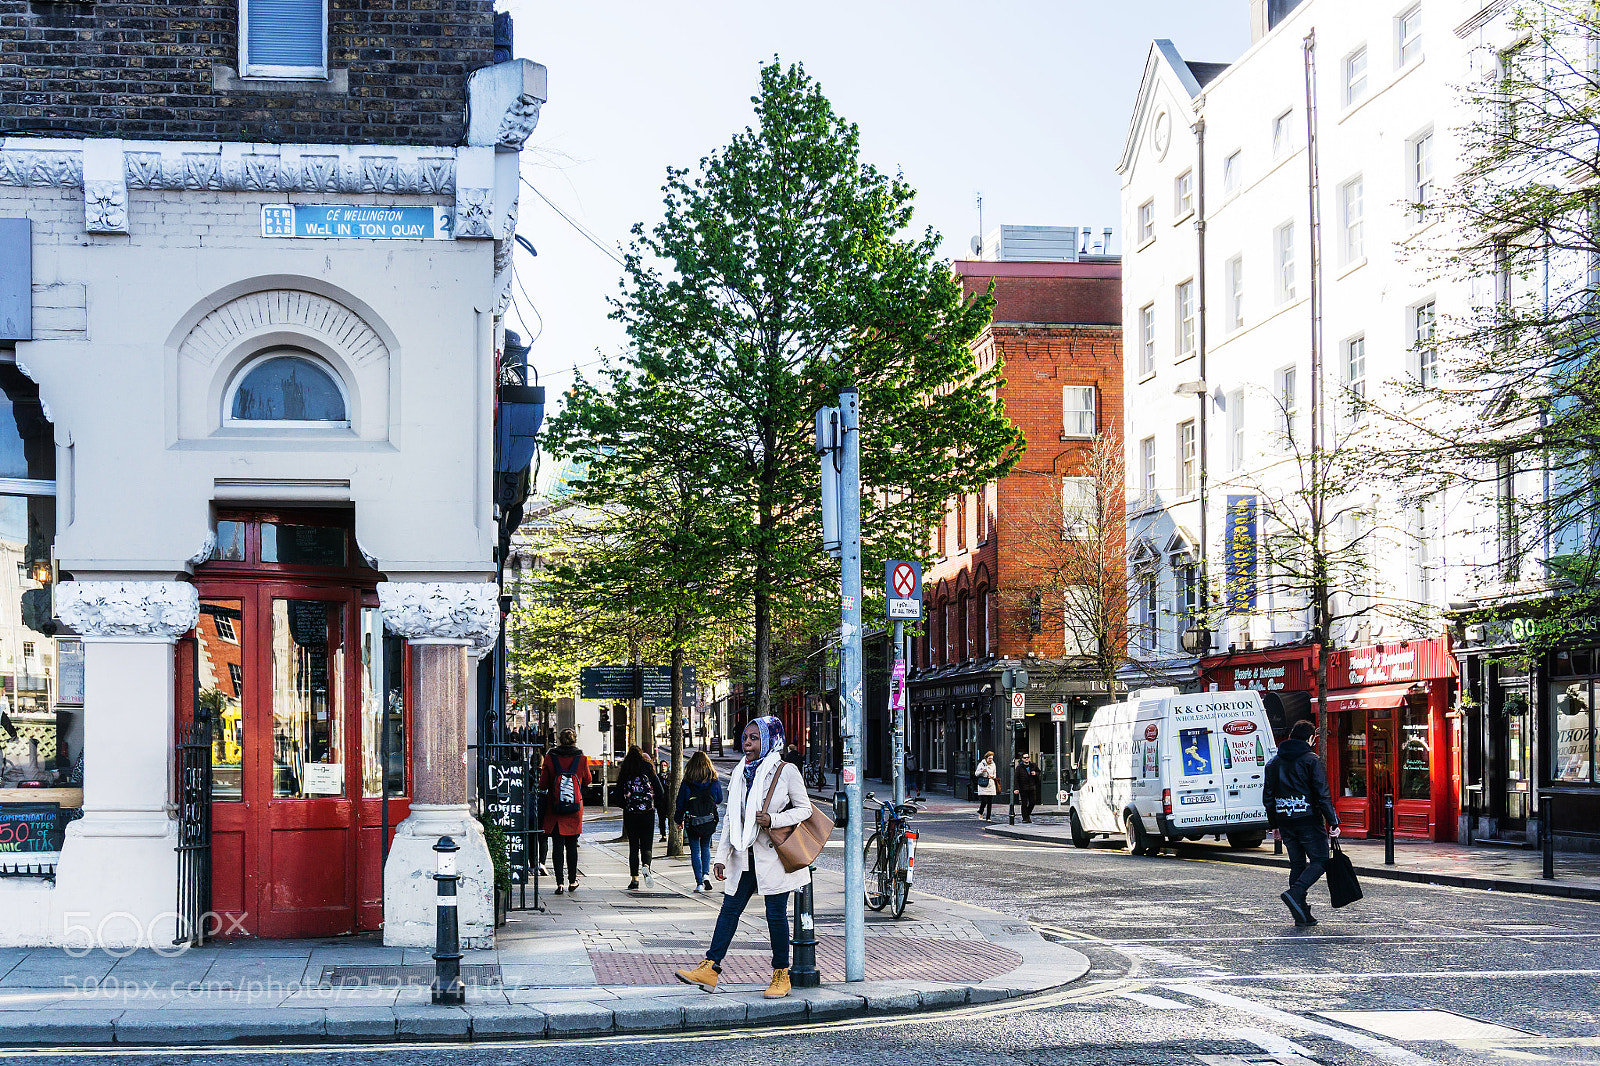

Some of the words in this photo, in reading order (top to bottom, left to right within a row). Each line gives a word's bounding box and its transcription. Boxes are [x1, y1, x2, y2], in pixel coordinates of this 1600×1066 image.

[265, 209, 291, 217] TEM
[326, 208, 341, 221] CÉ
[343, 210, 403, 222] WELLINGTON
[265, 218, 291, 226] PLE
[439, 214, 451, 232] 2
[265, 226, 291, 234] BAR
[391, 224, 425, 236] QUAY
[1330, 653, 1341, 668] 24
[1174, 706, 1183, 715] K
[1185, 705, 1193, 714] &
[1195, 704, 1204, 713] C
[1205, 700, 1253, 712] NORTON
[1175, 714, 1216, 722] WHOLESALE
[1217, 711, 1239, 719] FOODS
[1231, 740, 1254, 750] Italy's
[1234, 748, 1248, 756] No.
[1232, 755, 1256, 764] Water
[29, 822, 55, 830] TYPES
[36, 829, 48, 839] OF
[27, 838, 54, 852] TEAS
